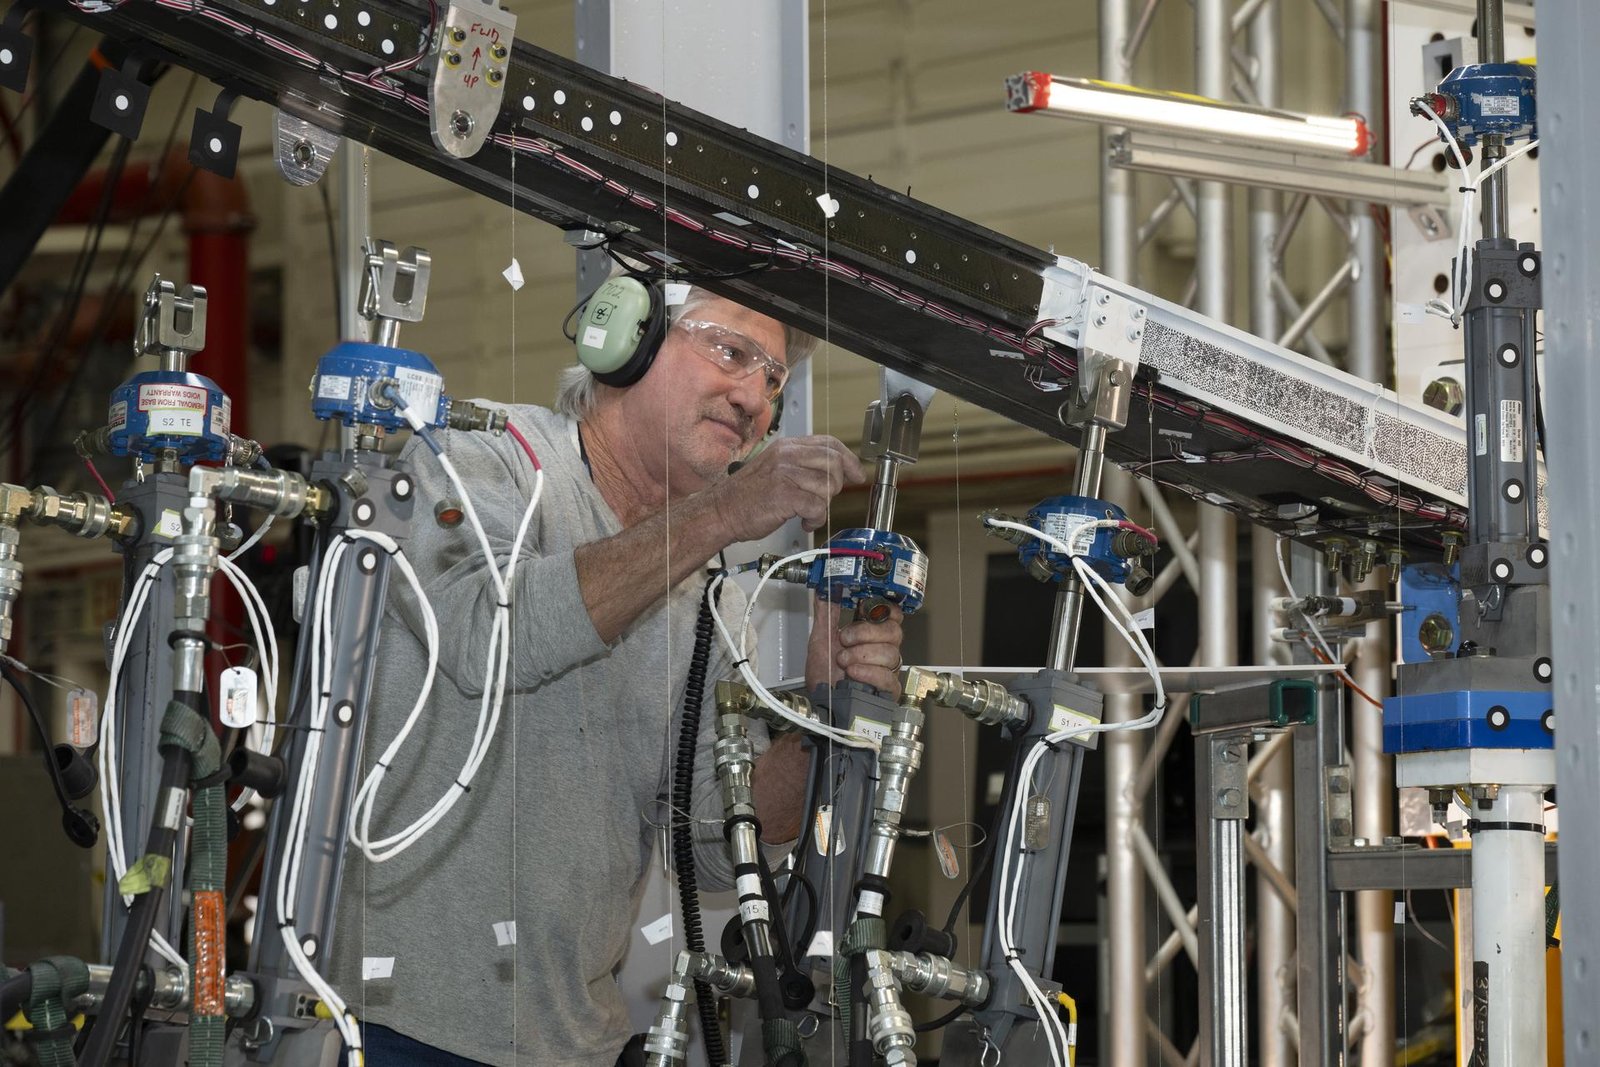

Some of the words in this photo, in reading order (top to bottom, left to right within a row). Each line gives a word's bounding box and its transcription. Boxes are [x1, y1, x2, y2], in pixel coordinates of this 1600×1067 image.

[471, 23, 500, 45] FWD
[146, 389, 181, 398] WARRANTY
[182, 390, 201, 400] VOIDS
[140, 398, 157, 407] BASE
[157, 398, 176, 407] FROM
[177, 399, 205, 410] REMOVAL
[161, 417, 175, 427] S2
[180, 418, 192, 427] TE
[170, 522, 181, 532] S2
[1060, 717, 1070, 727] S1
[873, 730, 882, 740] TE
[746, 904, 759, 915] 15
